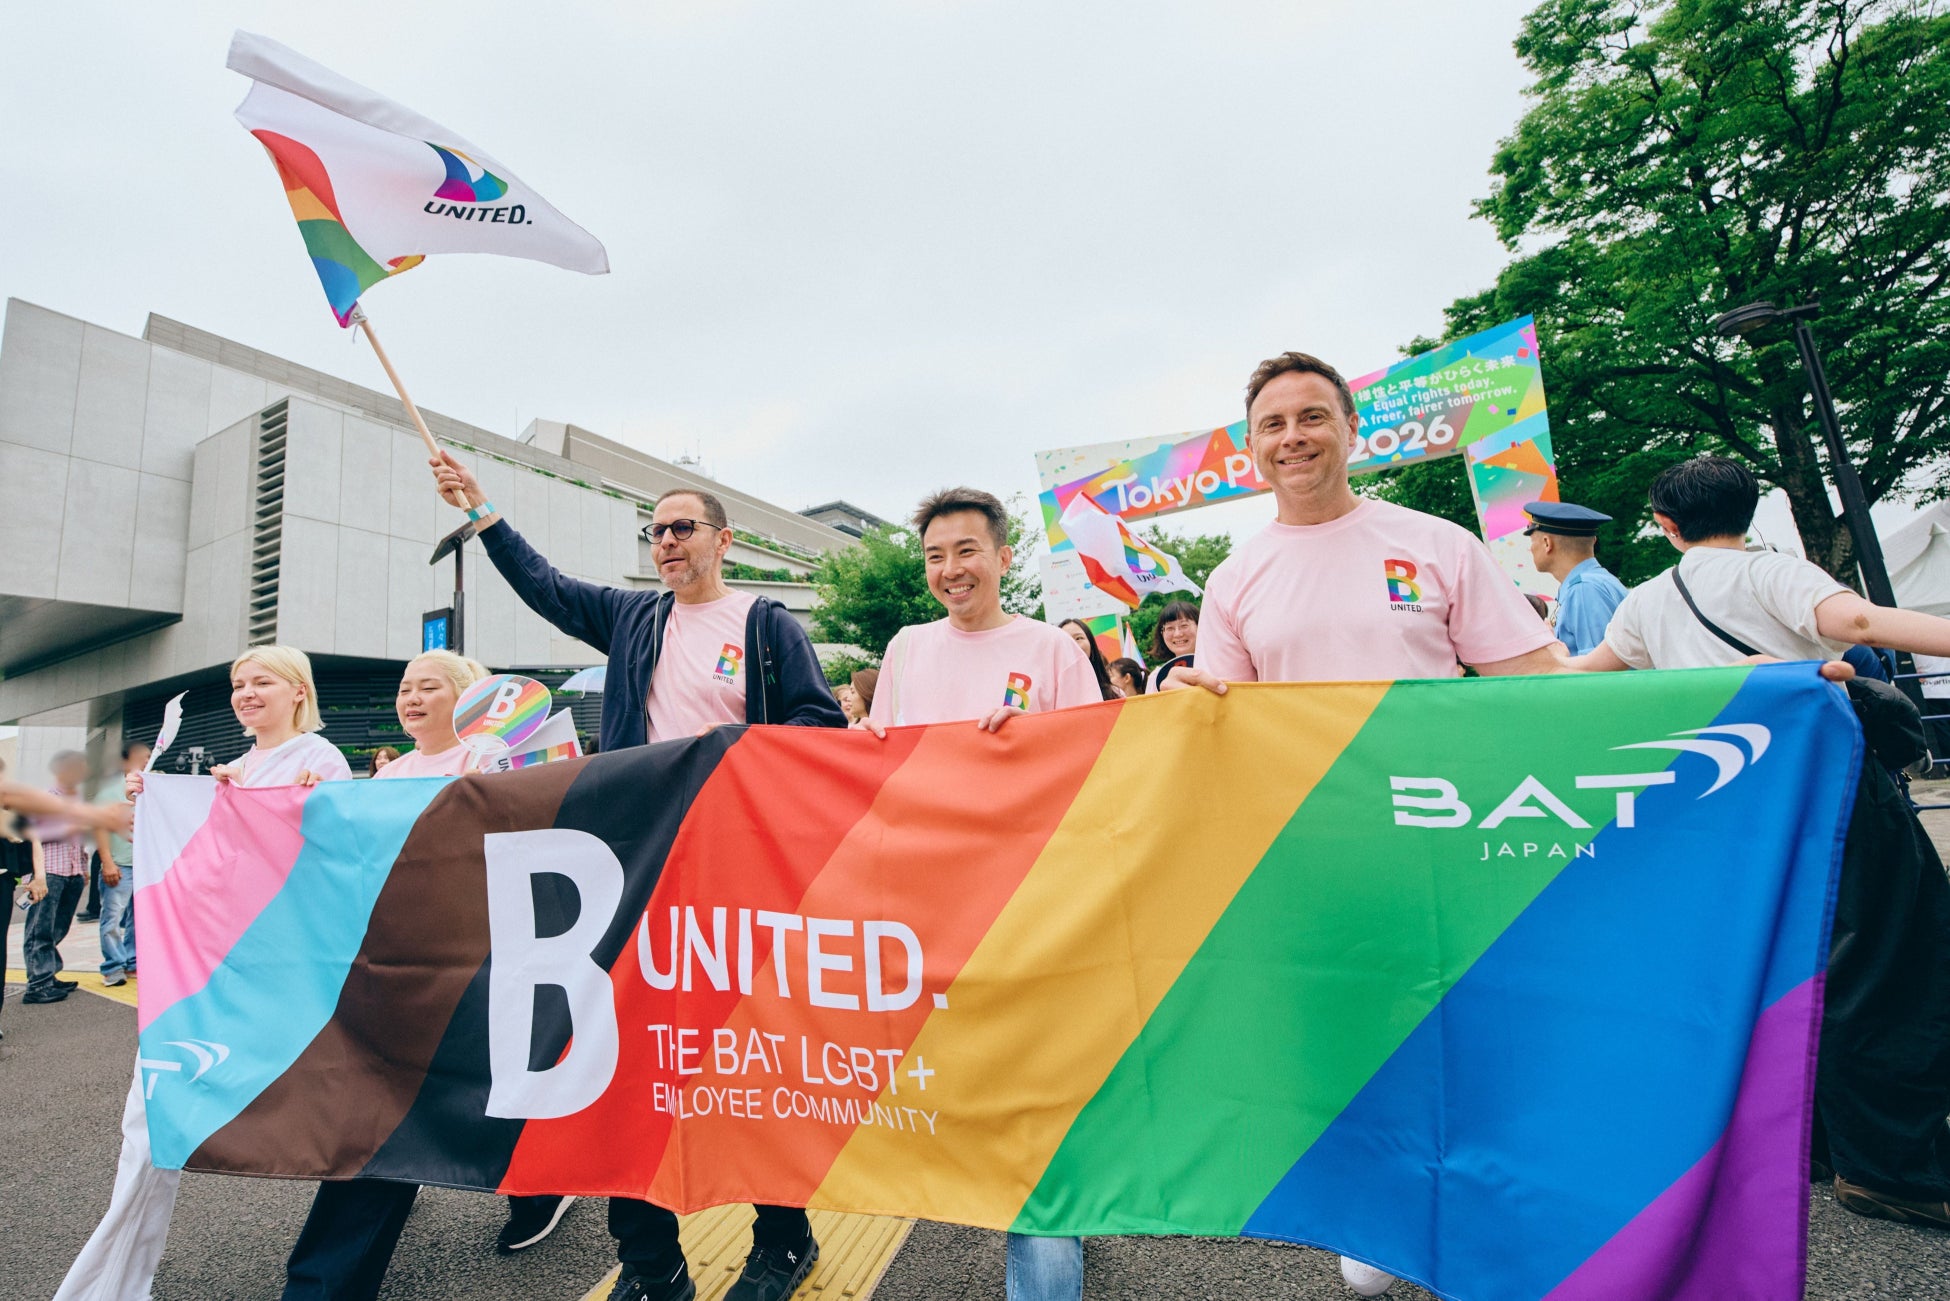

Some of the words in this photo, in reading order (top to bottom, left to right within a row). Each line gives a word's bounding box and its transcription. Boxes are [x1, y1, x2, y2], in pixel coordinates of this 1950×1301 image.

[423, 201, 533, 225] UNITED.
[1353, 355, 1516, 403] 様性と平等がひらく未来
[1373, 394, 1408, 412] Equal
[1412, 387, 1450, 404] rights
[1454, 377, 1494, 394] today.
[1359, 417, 1368, 428] A
[1371, 411, 1406, 425] freer,
[1408, 401, 1443, 417] fairer
[1448, 386, 1517, 408] tomorrow.
[1347, 415, 1454, 464] 2026
[1101, 470, 1221, 512] Tokyo
[1384, 559, 1422, 602] B
[1390, 603, 1424, 613] UNITED.
[715, 643, 743, 676] B
[487, 682, 522, 719] B
[1003, 671, 1032, 711] B
[1389, 770, 1676, 829] BAT
[1480, 842, 1596, 861] JAPAN
[484, 828, 625, 1119] B
[637, 905, 949, 1012] UNITED.
[713, 1027, 785, 1076] BAT
[801, 1035, 935, 1095] LGBT+
[653, 1082, 763, 1119] EMLOYEE
[772, 1086, 939, 1136] COMMUNITY
